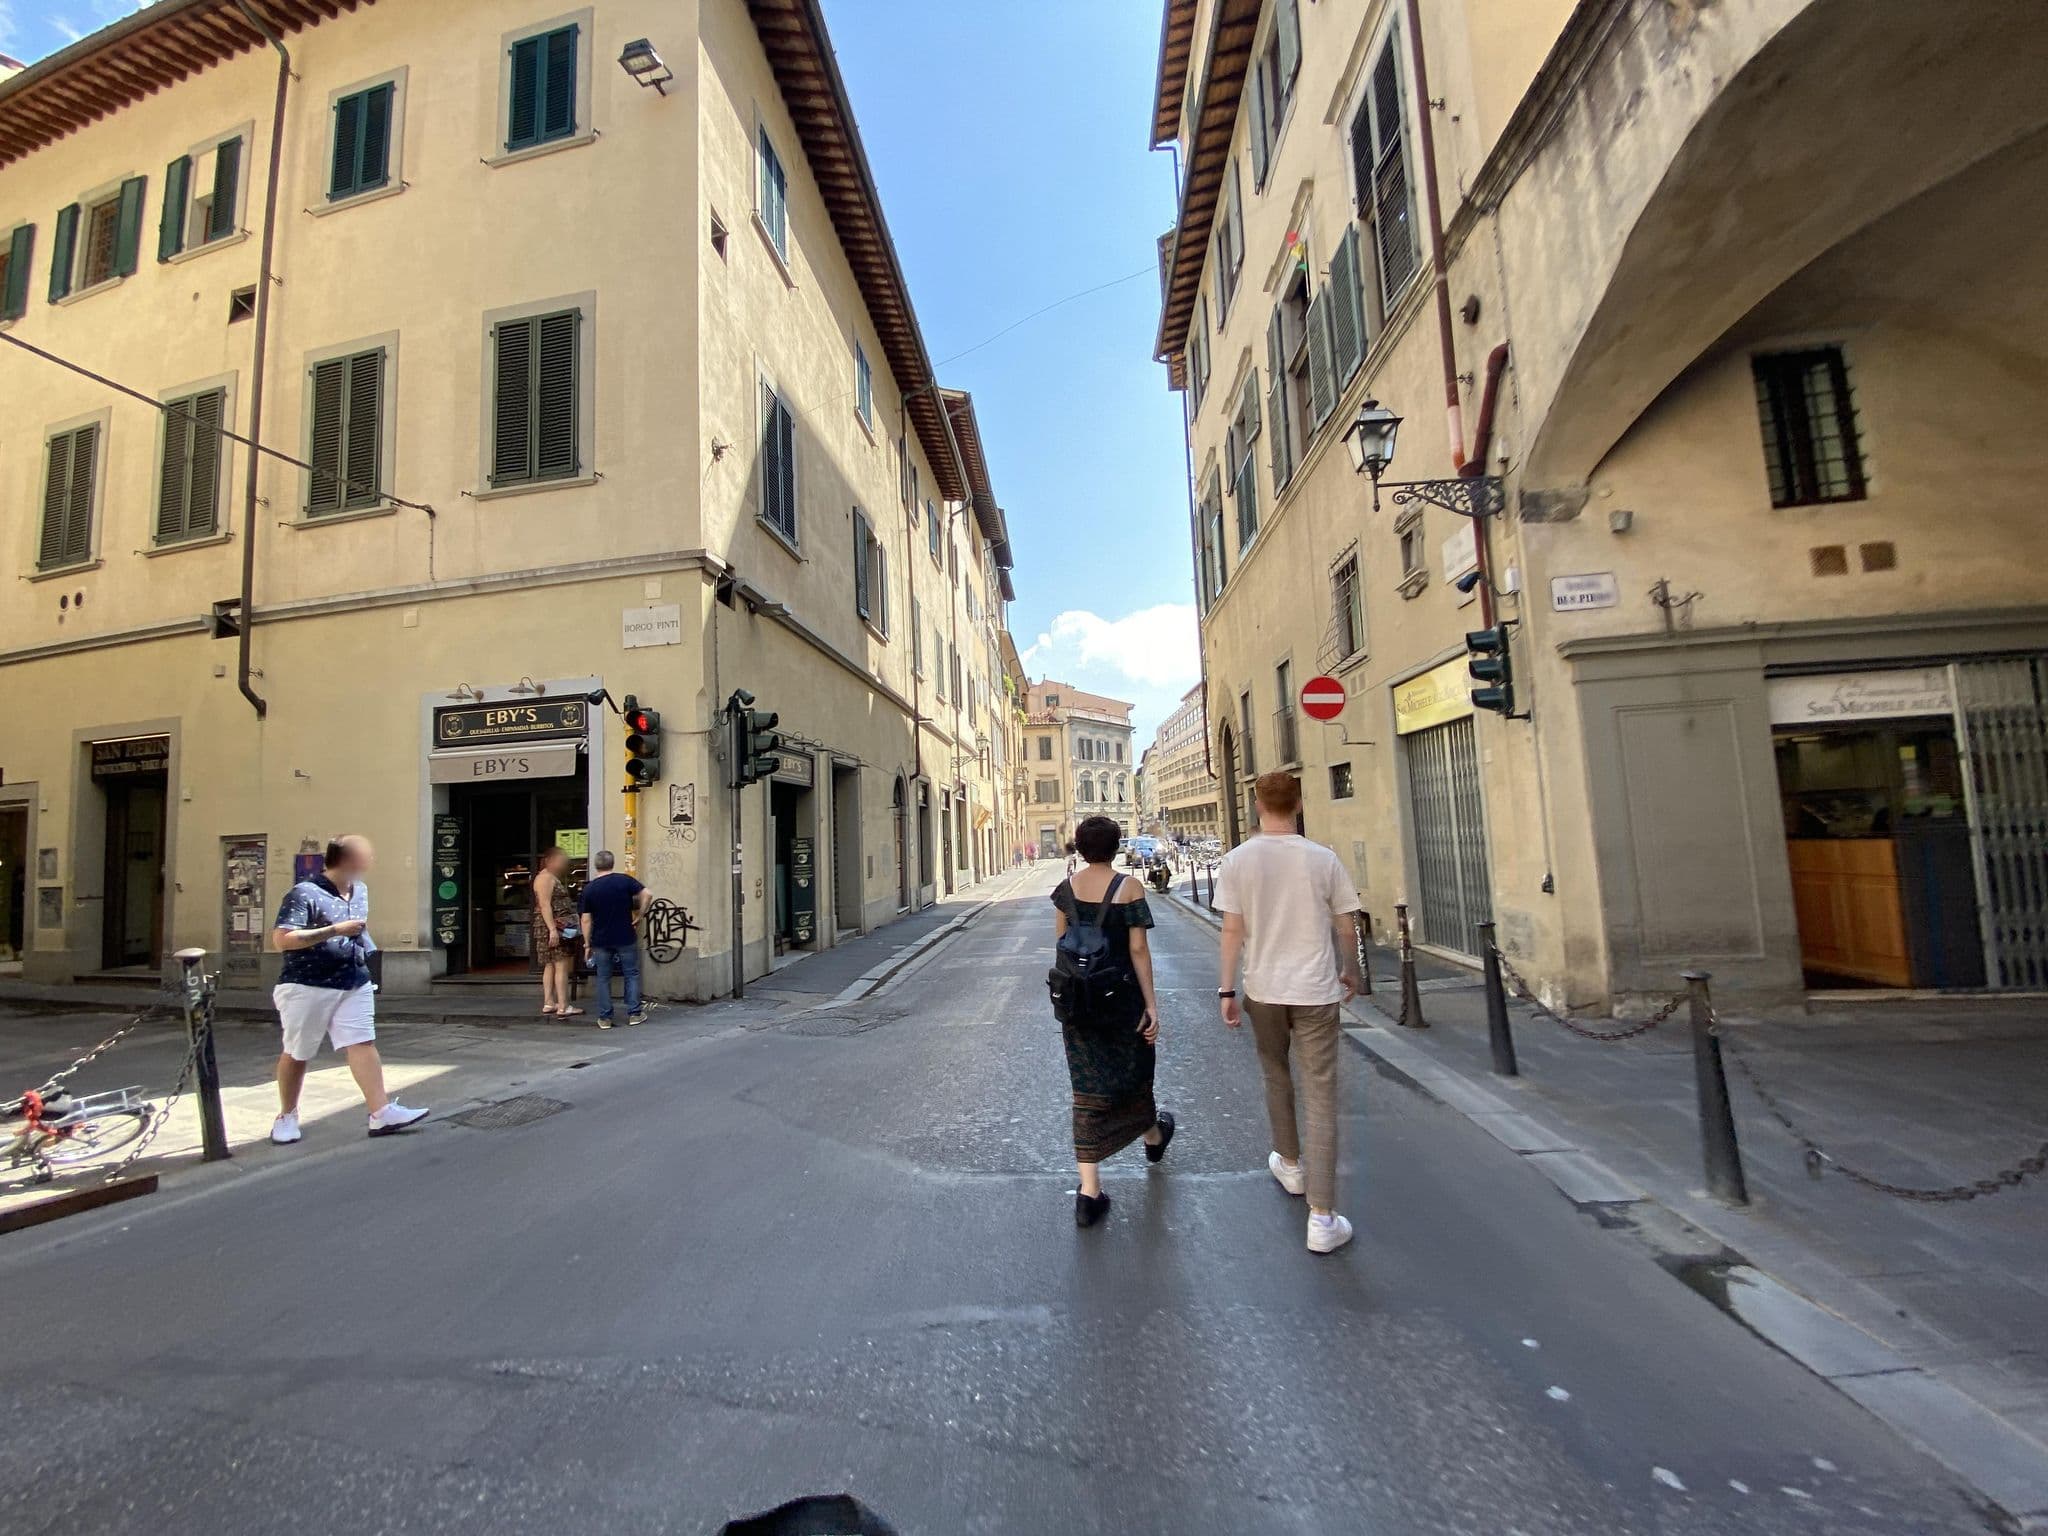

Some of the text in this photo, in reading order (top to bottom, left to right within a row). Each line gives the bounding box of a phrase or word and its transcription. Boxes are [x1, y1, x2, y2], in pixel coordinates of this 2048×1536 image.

[624, 619, 679, 633] BORGO PINTI
[486, 708, 538, 727] EBY'S
[530, 722, 554, 731] BURRITOS
[473, 758, 530, 776] EBY'S
[783, 757, 802, 772] EBY'S
